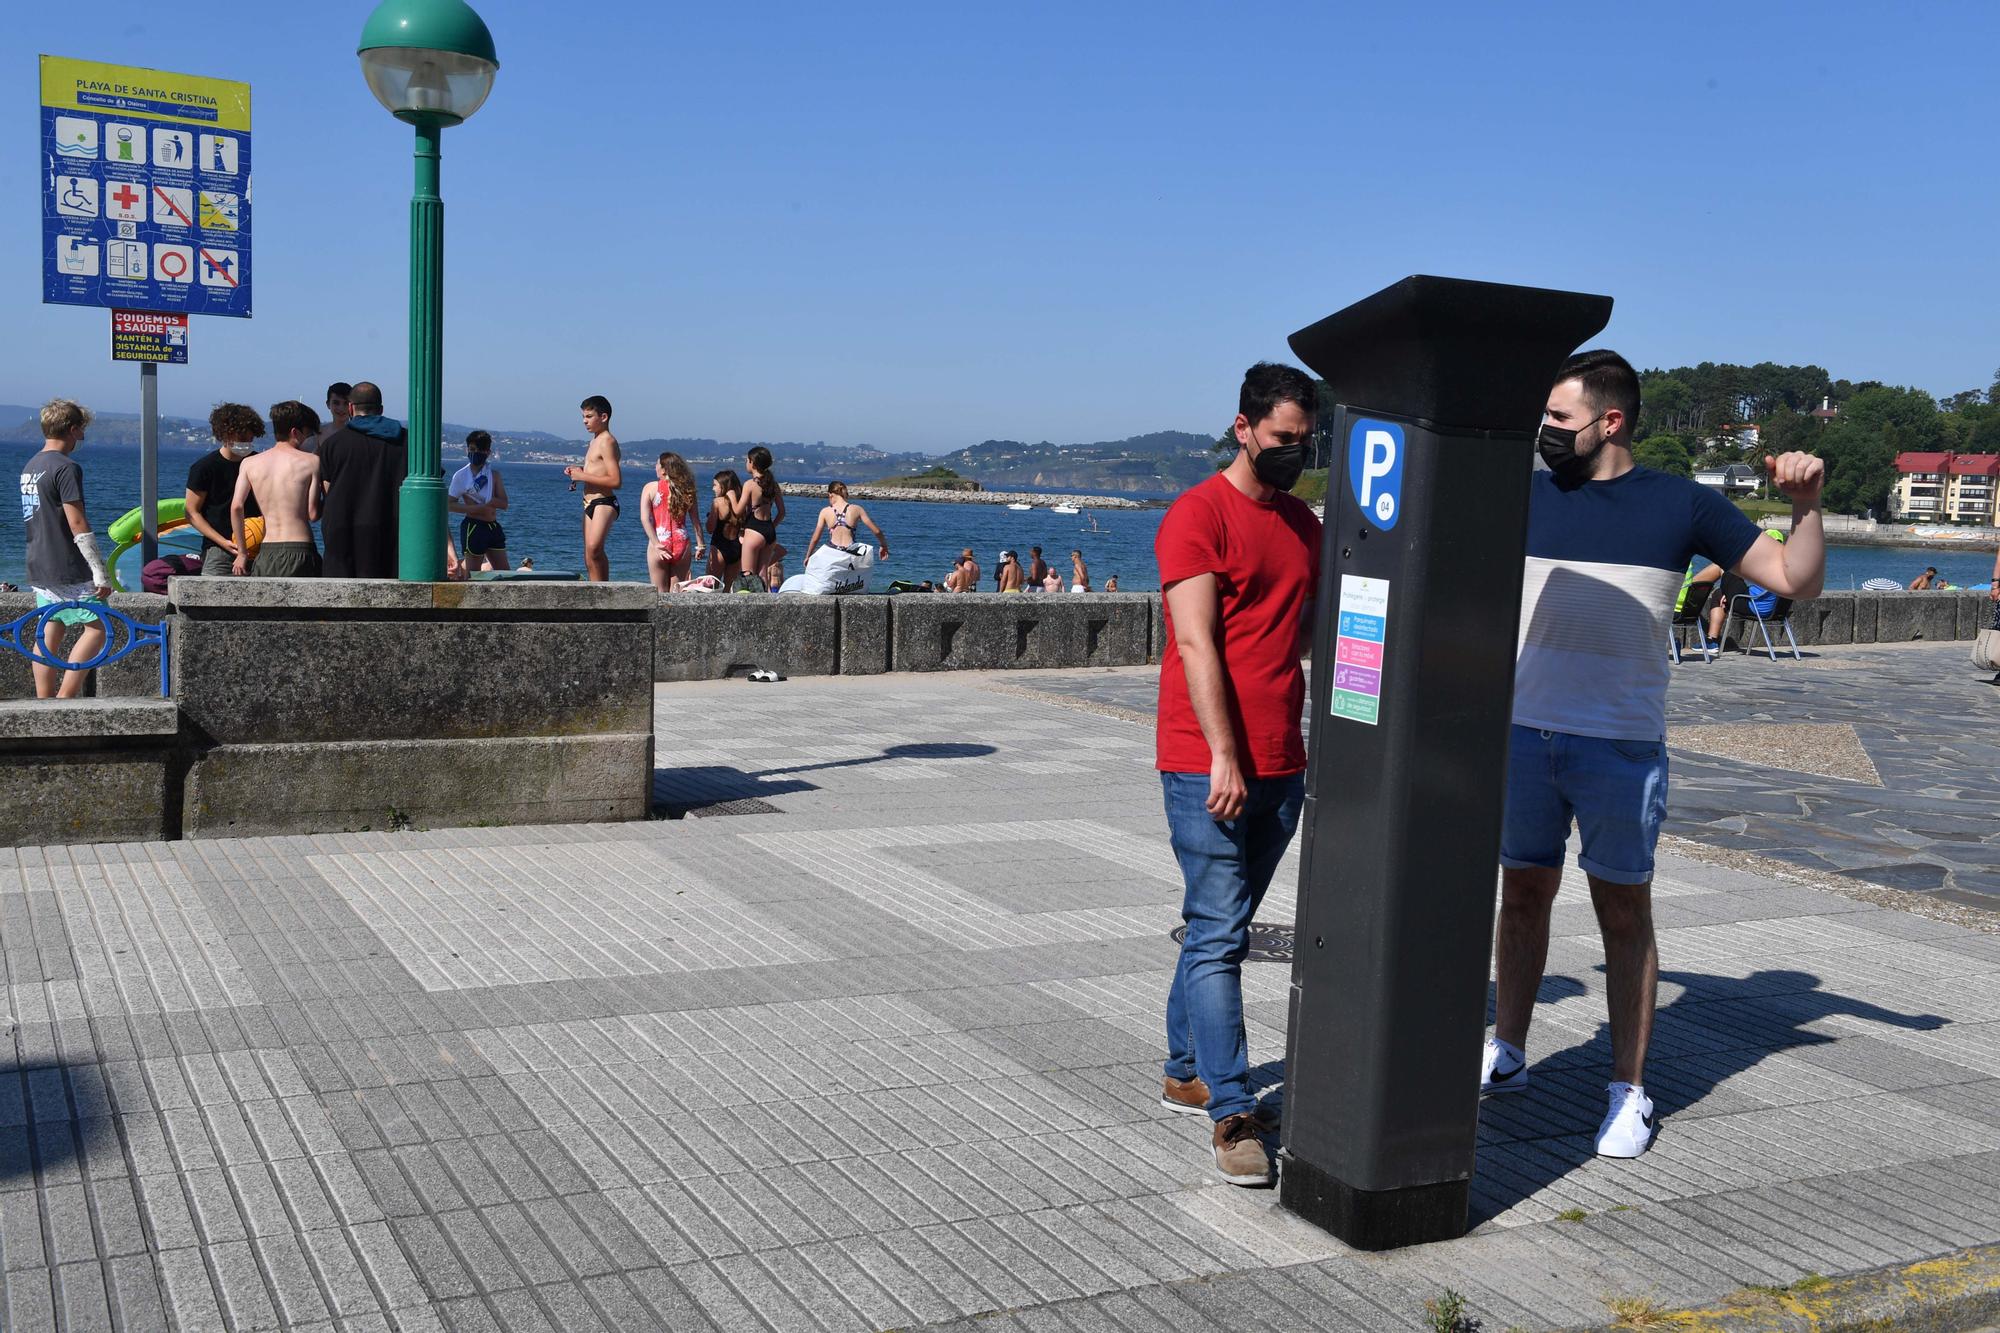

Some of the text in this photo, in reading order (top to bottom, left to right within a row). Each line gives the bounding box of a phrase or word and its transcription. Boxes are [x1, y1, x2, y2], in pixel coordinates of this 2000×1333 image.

[76, 79, 217, 106] PLAYA DE SANTA CRISTINA
[82, 94, 105, 103] Concello
[115, 313, 179, 325] COIDEMOS
[115, 322, 164, 334] a SAÚDE
[115, 334, 152, 343] MANTÉN
[115, 343, 160, 352] DISTANCIA
[115, 351, 169, 361] SEGURIDADE
[1360, 430, 1396, 507] P
[1380, 501, 1390, 512] 04
